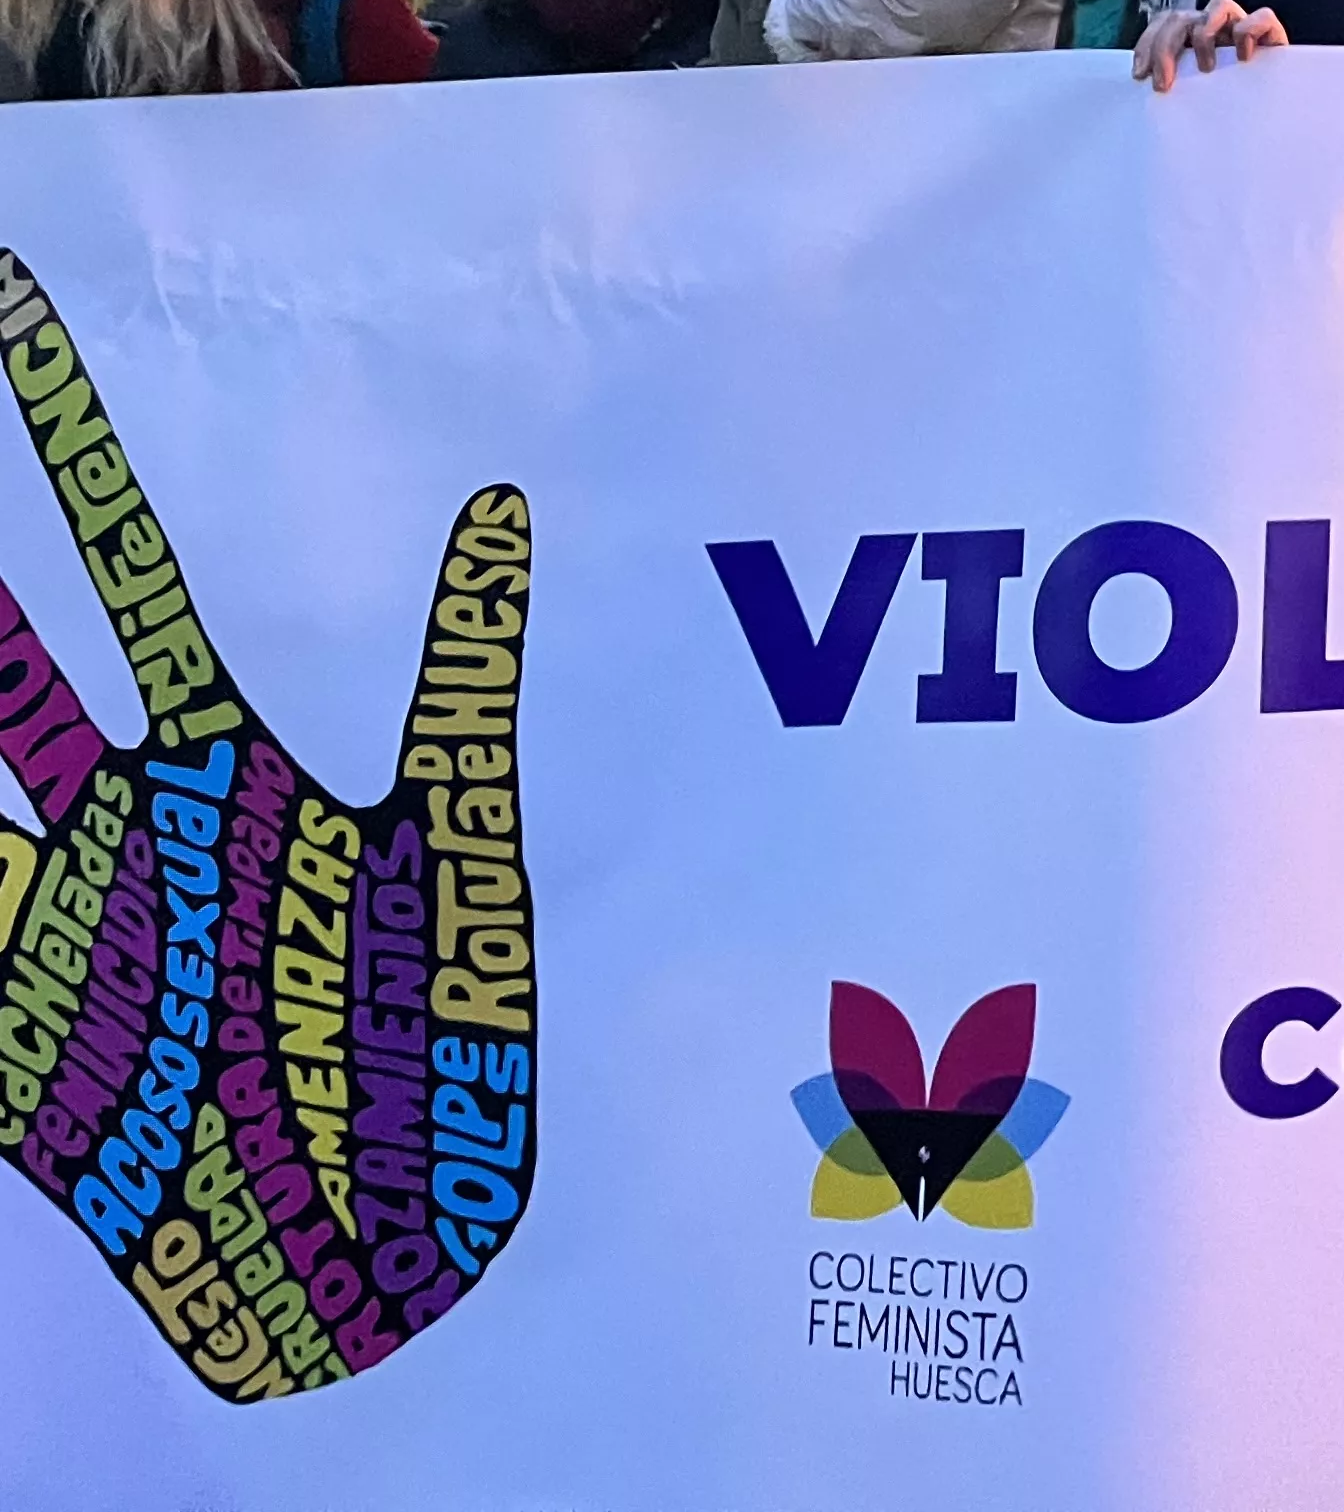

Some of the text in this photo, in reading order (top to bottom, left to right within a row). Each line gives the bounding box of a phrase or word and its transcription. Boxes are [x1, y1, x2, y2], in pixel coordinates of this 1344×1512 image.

[808, 1251, 1029, 1305] COLECTIVO
[807, 1298, 1024, 1363] FEMINISTA
[889, 1360, 1024, 1407] HUESCA
